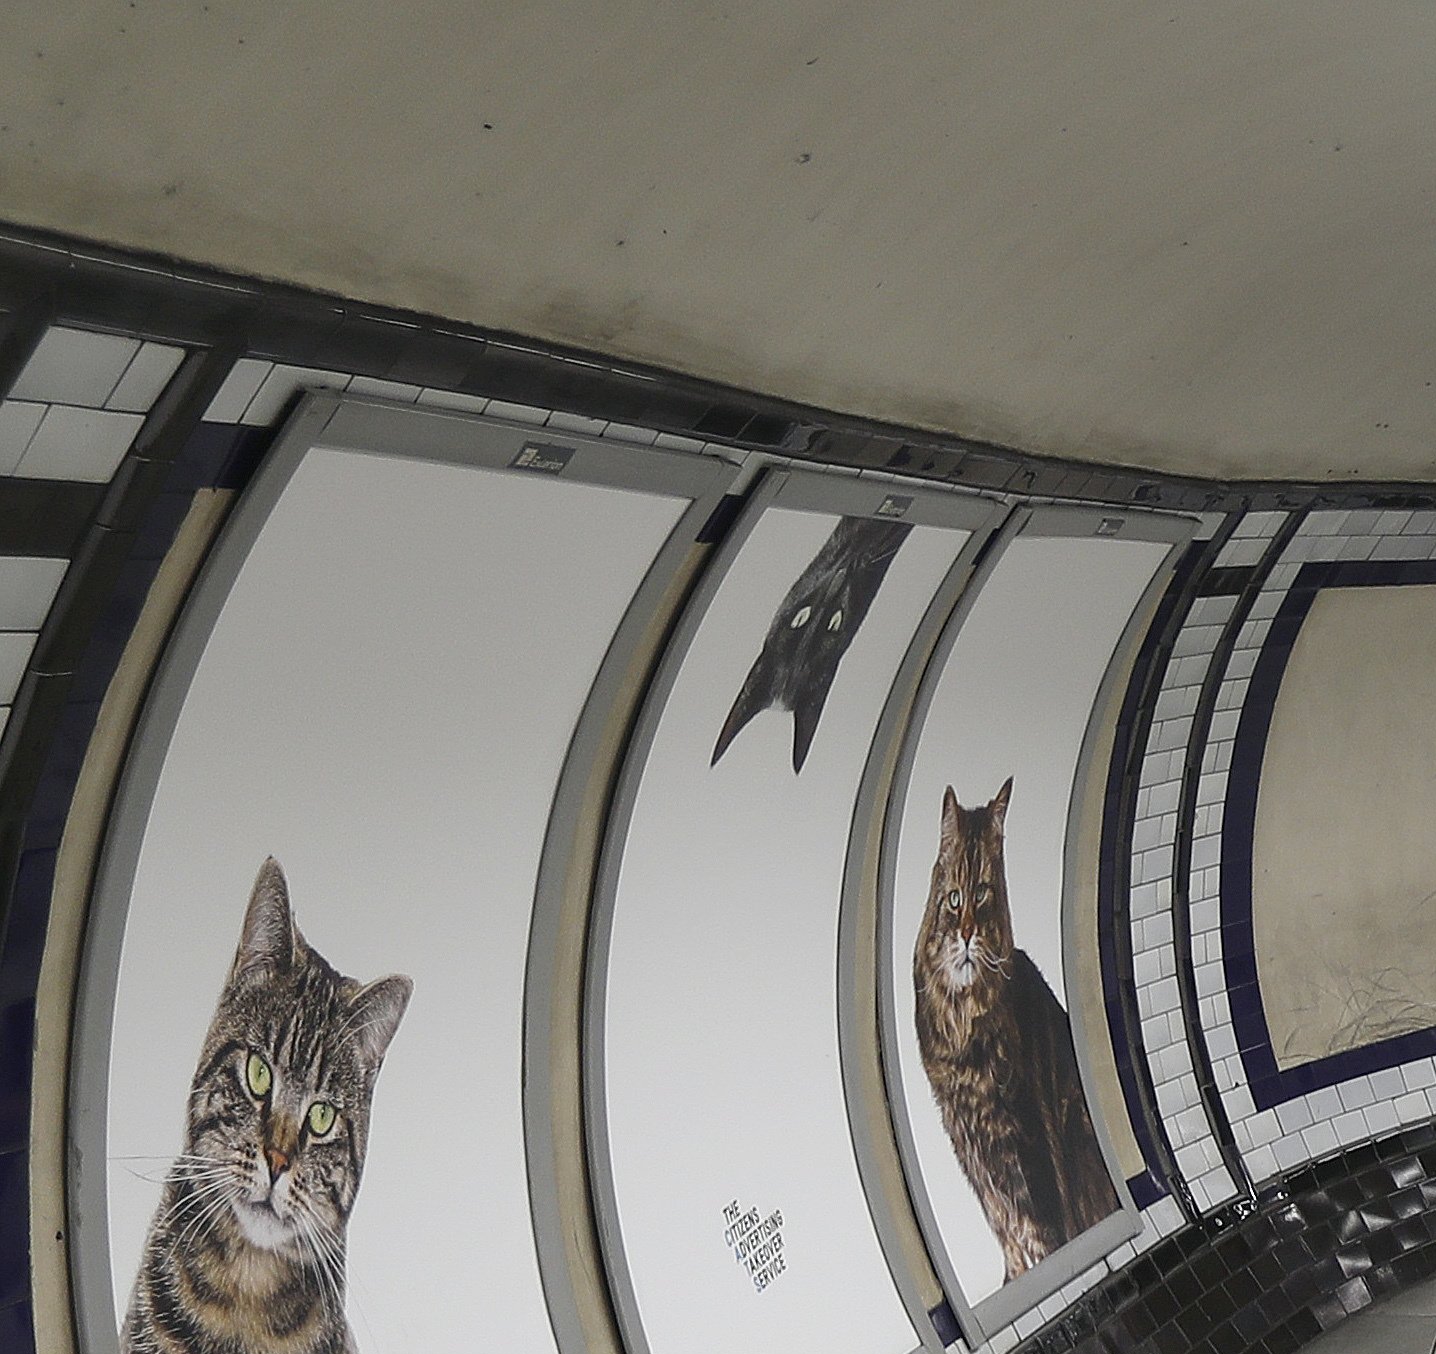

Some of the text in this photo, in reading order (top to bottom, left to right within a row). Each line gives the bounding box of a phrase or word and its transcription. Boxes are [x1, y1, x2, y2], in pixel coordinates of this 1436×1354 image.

[723, 1199, 740, 1225] THE
[724, 1206, 760, 1247] CITIZENS
[735, 1209, 783, 1263] ADVERTISING
[743, 1232, 784, 1277] TAKEOVER
[753, 1252, 786, 1293] SERVICE
